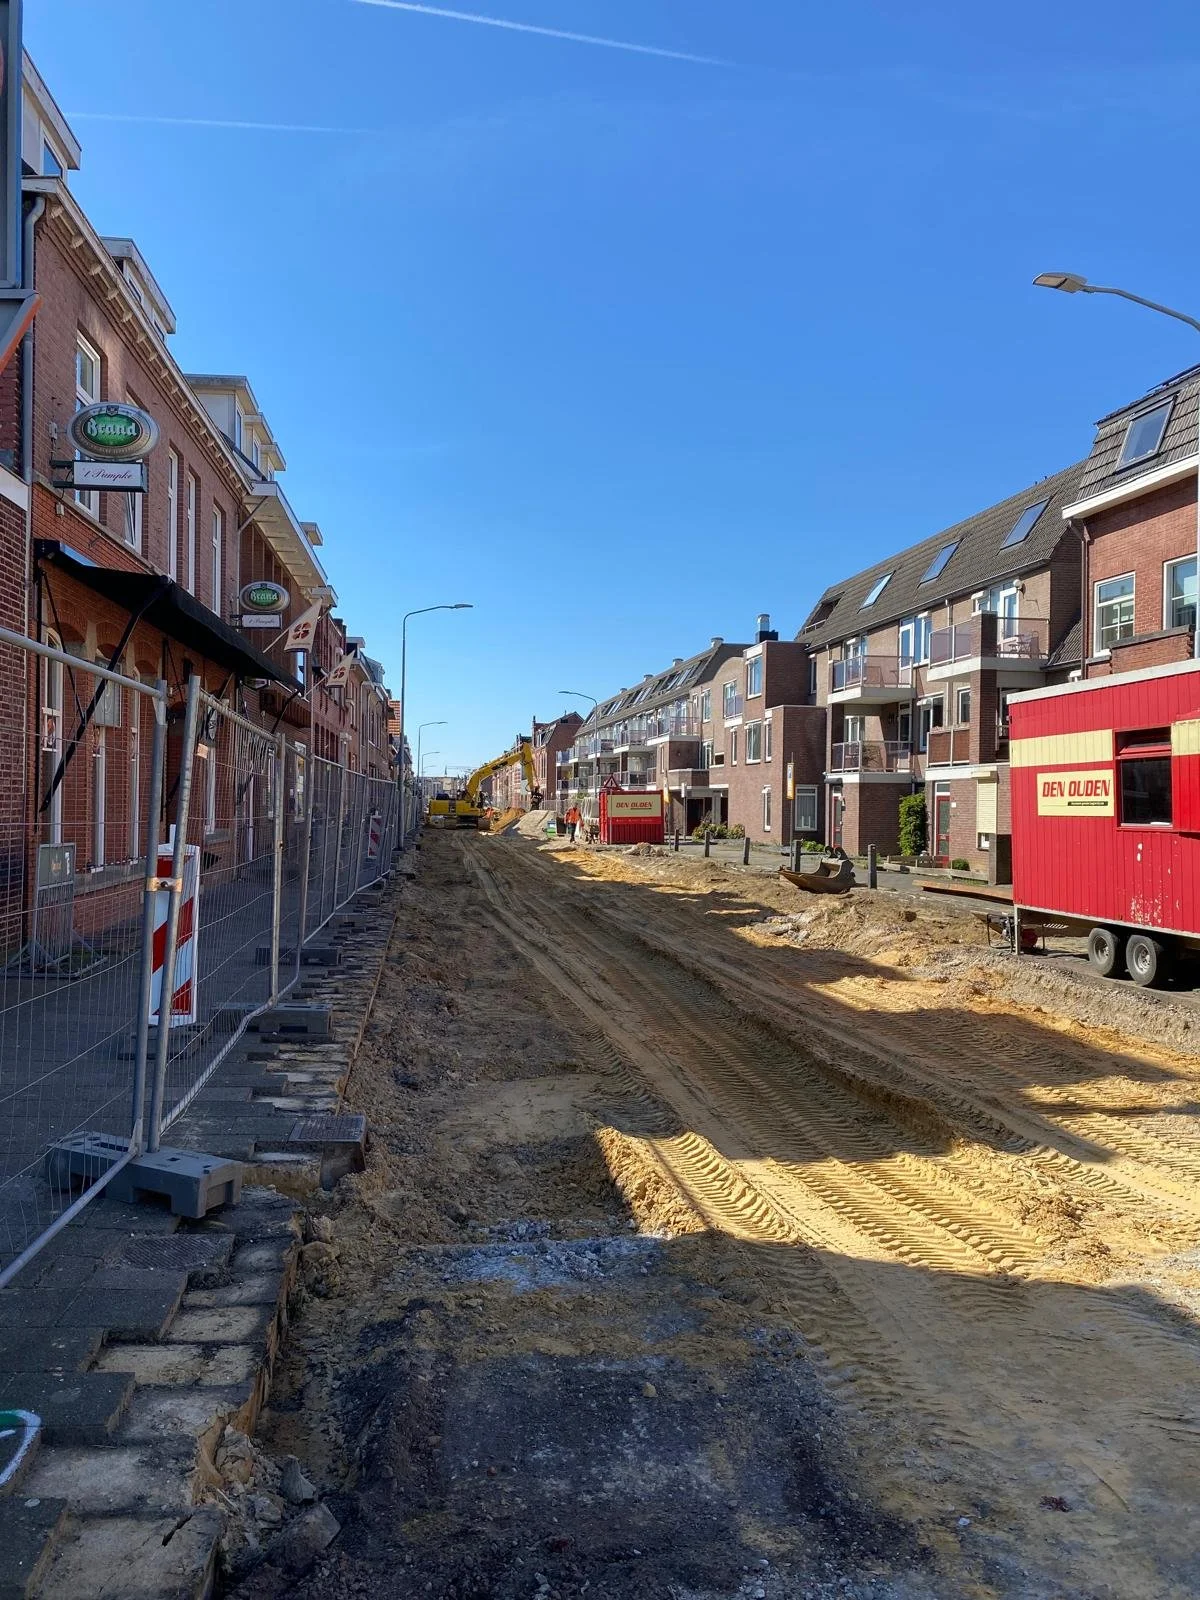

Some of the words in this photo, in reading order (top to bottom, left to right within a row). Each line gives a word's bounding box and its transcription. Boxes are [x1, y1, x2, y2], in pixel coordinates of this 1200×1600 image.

[87, 418, 137, 437] Brand
[250, 590, 278, 601] Brand
[1042, 781, 1065, 797] DEN
[1068, 779, 1110, 797] OUDEN
